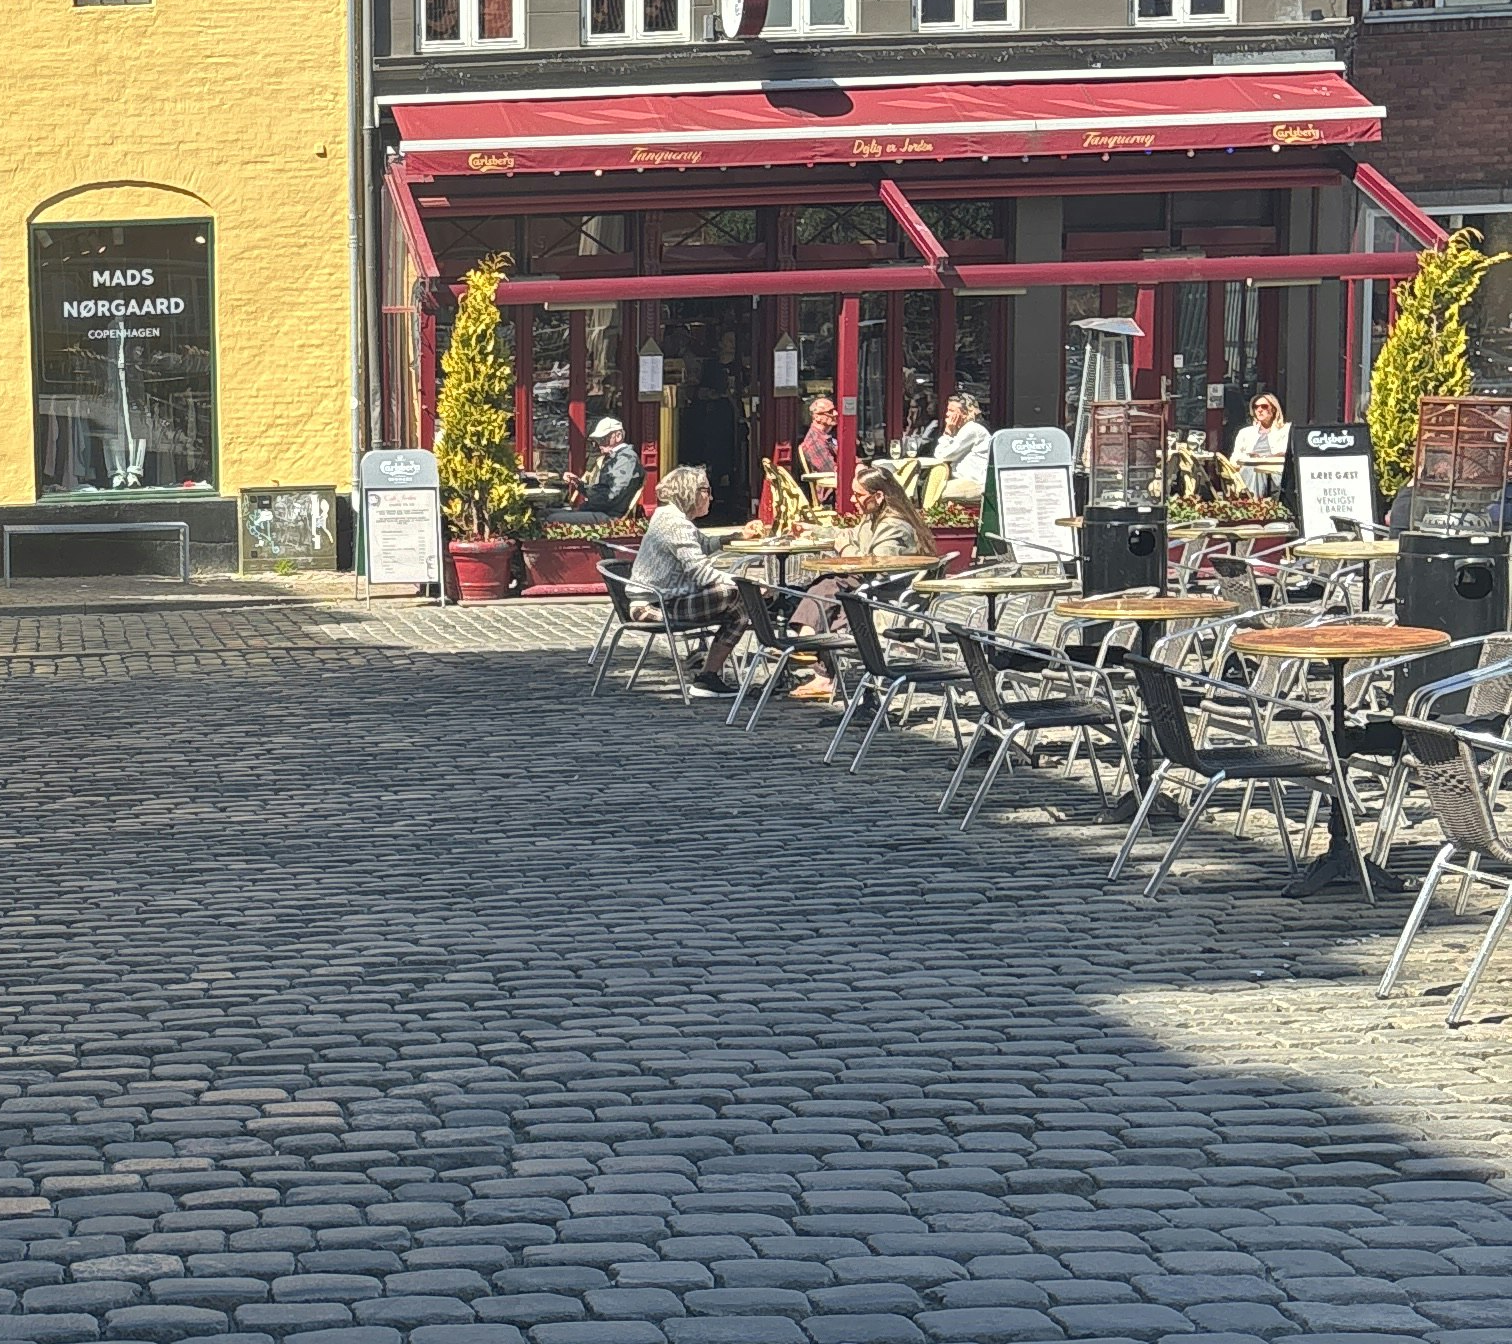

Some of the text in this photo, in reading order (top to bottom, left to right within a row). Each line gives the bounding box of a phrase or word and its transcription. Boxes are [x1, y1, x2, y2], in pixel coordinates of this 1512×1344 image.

[1082, 131, 1156, 149] Tanqueray
[1272, 123, 1320, 144] Carlsberg
[899, 137, 934, 153] Jorden
[468, 151, 515, 173] Carlsberg
[628, 147, 702, 165] Tanqueray
[91, 268, 155, 288] MADS
[62, 297, 185, 318] NØRGAARD
[87, 327, 161, 340] COPENHAGEN
[1011, 438, 1052, 456] Carlsberg
[1308, 429, 1355, 451] Carlsberg
[379, 460, 421, 477] Carlsberg
[1316, 495, 1356, 505] VENLIGST
[1322, 487, 1348, 497] BESTIL
[1325, 504, 1353, 513] BAREN
